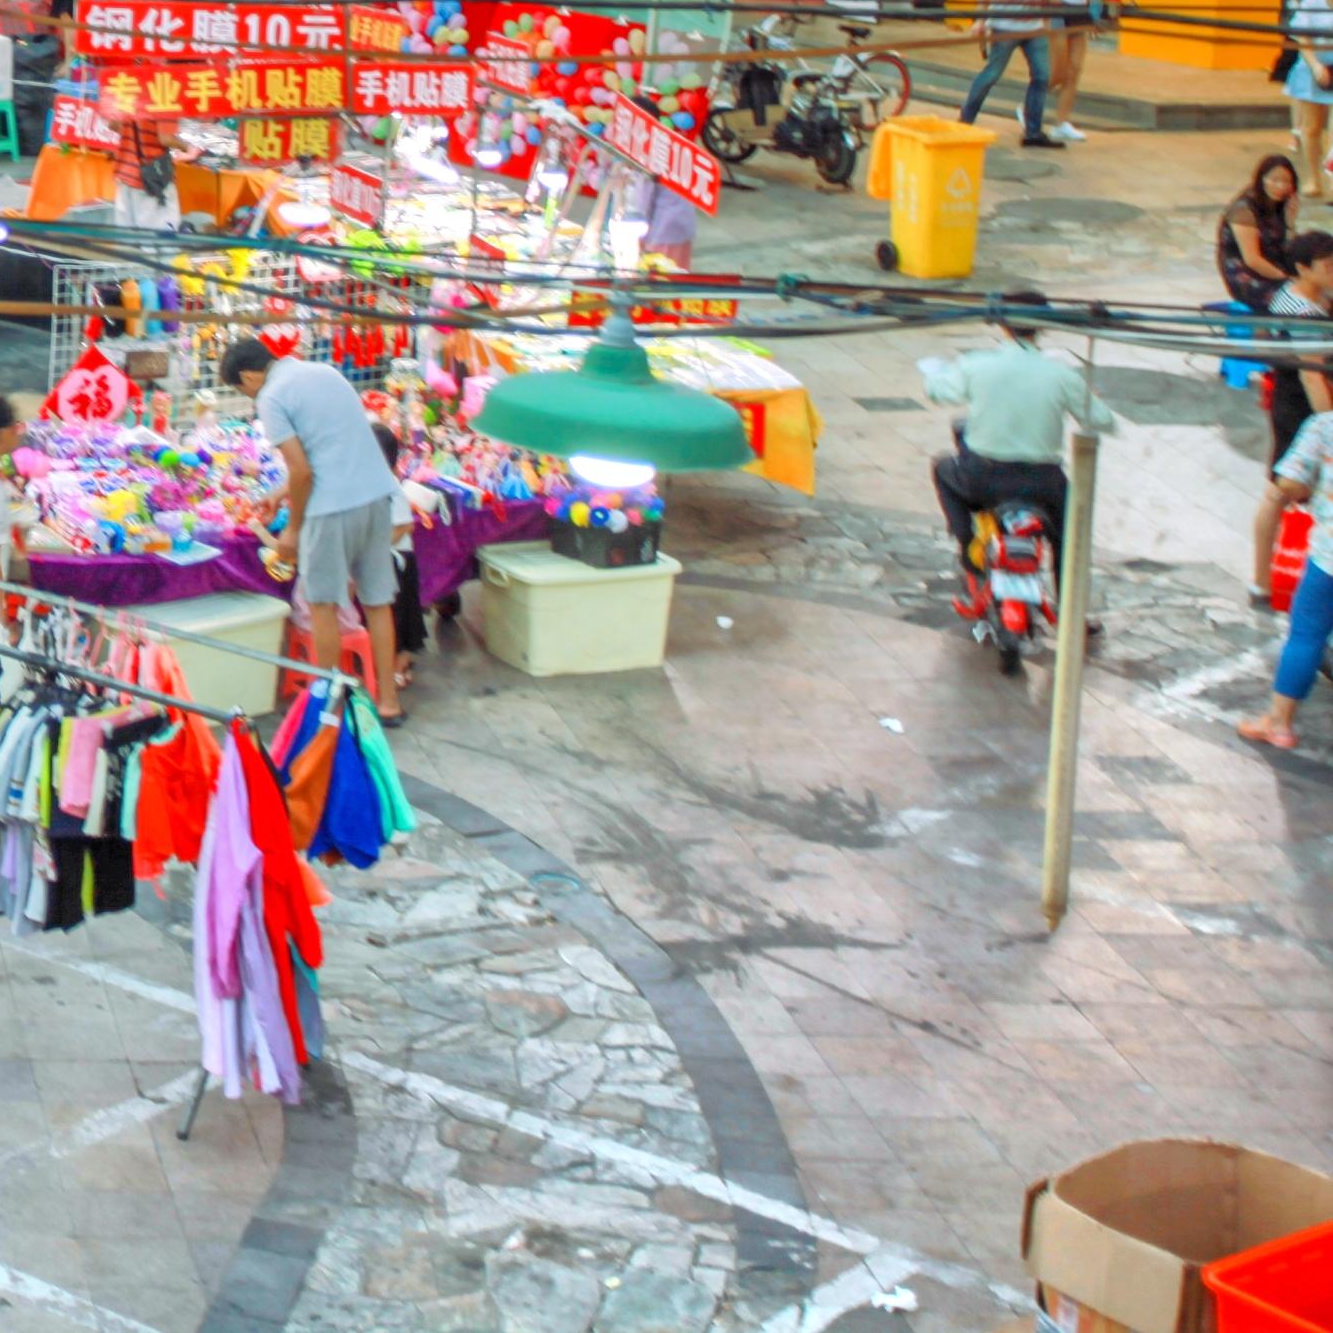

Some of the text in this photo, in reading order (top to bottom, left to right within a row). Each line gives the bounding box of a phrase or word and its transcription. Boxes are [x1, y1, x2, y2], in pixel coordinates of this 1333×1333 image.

[106, 64, 346, 114] 专业手机贴膜
[355, 68, 471, 109] 手机贴膜
[244, 117, 331, 160] 贴膜
